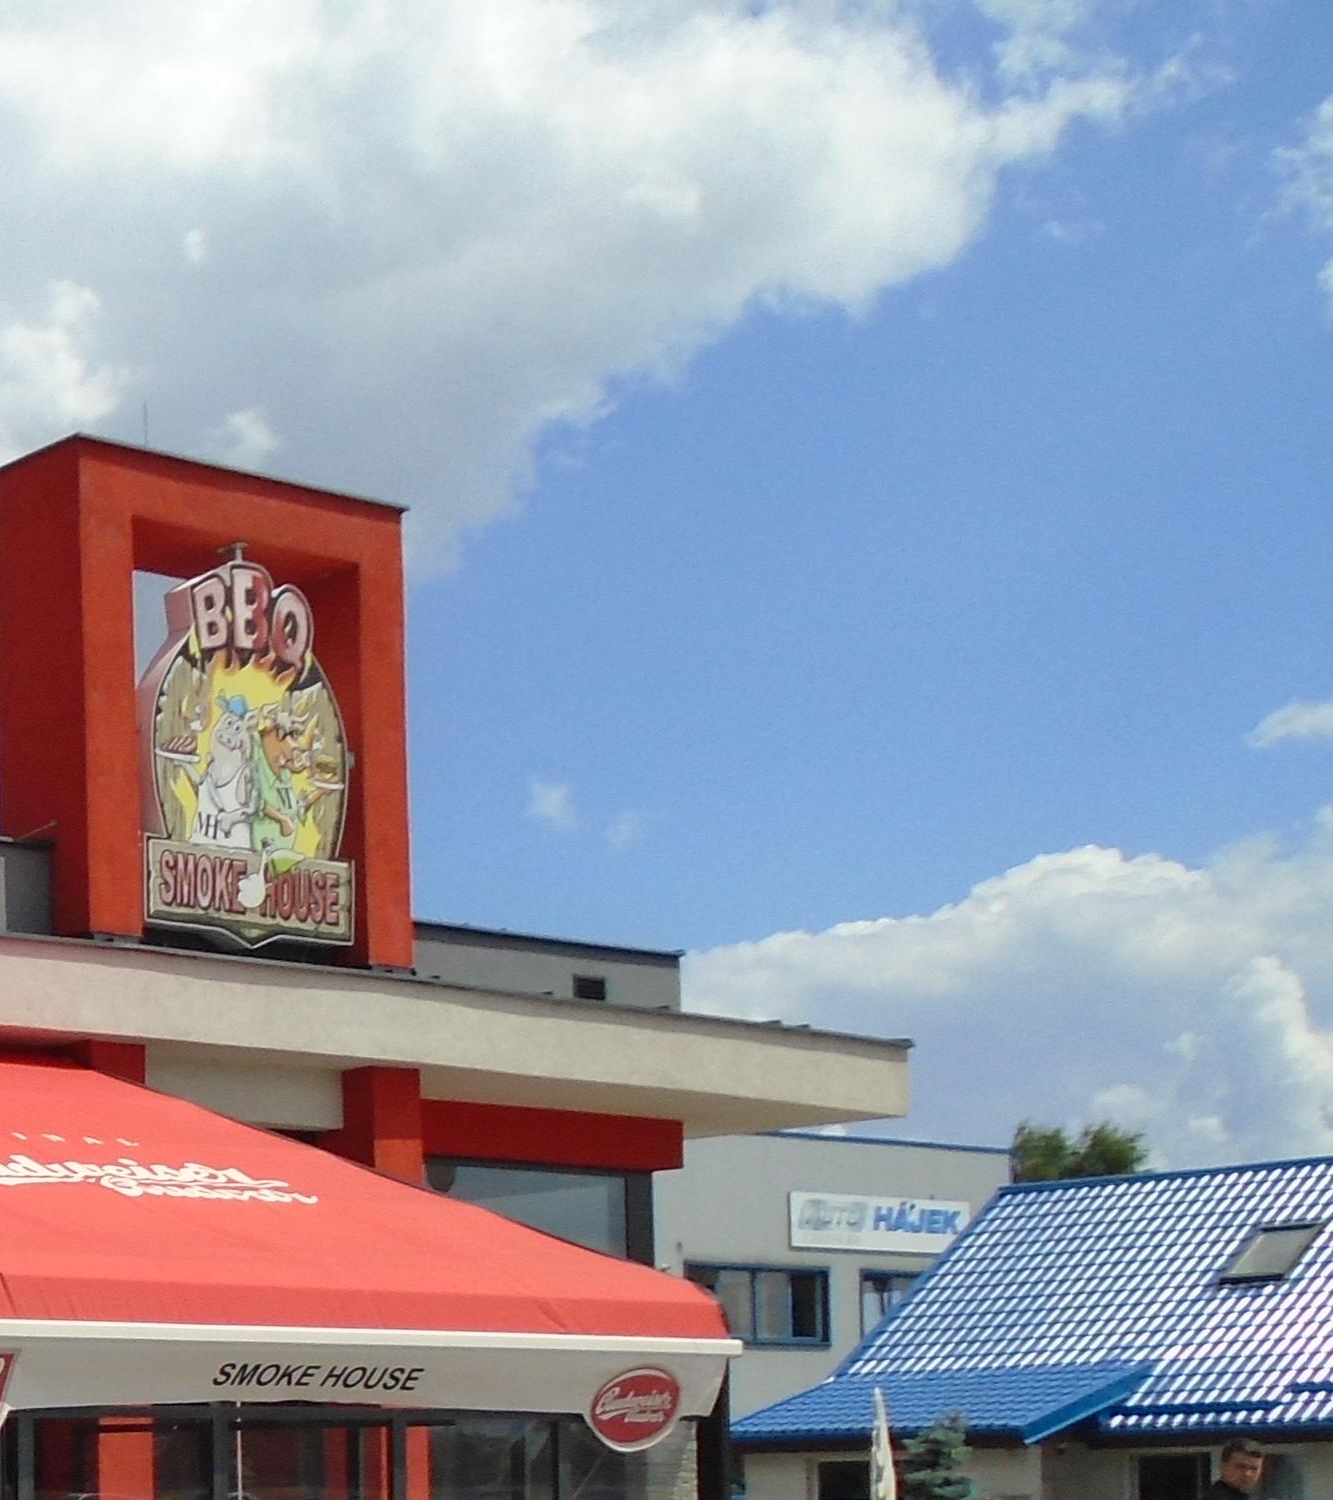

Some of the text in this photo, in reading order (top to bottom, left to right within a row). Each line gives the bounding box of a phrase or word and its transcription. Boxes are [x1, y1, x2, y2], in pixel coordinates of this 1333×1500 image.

[192, 565, 305, 669] BBQ
[159, 850, 339, 925] SMOKE HOUSE
[211, 1361, 425, 1391] SMOKE HOUSE
